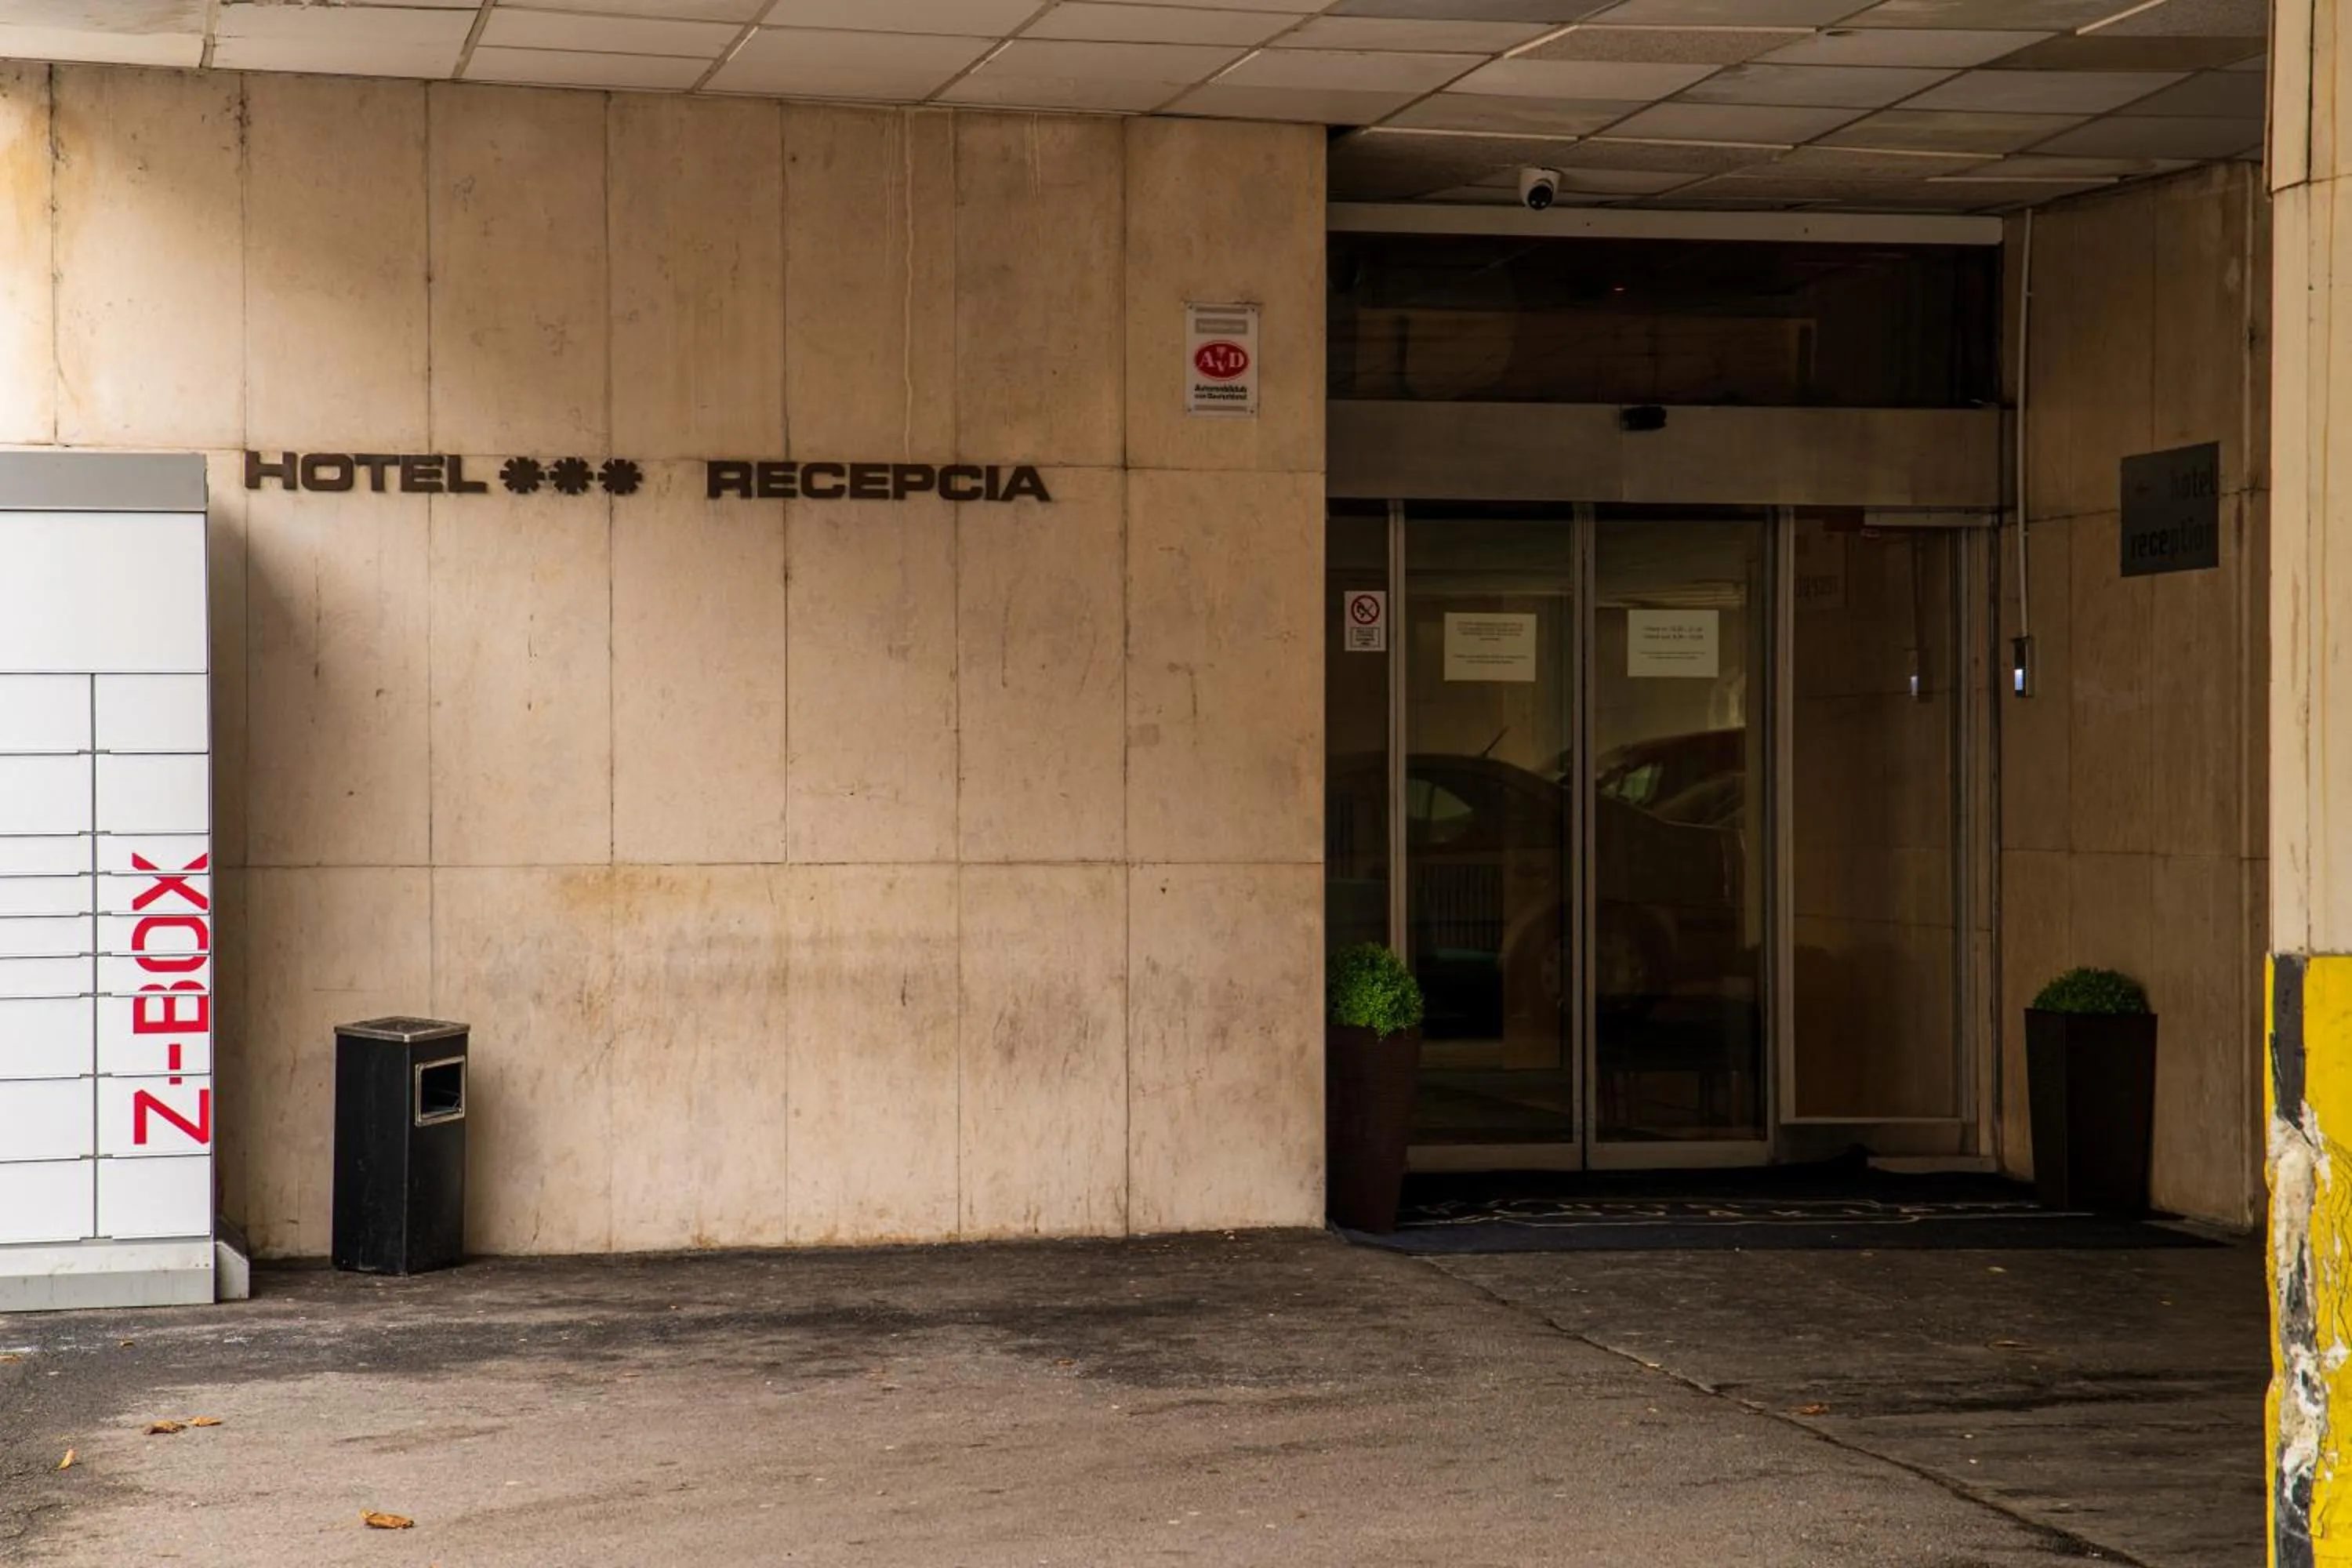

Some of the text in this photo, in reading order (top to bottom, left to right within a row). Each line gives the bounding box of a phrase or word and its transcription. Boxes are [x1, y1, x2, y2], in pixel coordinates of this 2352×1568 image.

[245, 452, 1051, 502] HOTEL RECEPCIA
[2169, 462, 2216, 503] hotel
[2130, 516, 2216, 561] reception
[131, 852, 210, 1145] Z-BOX
